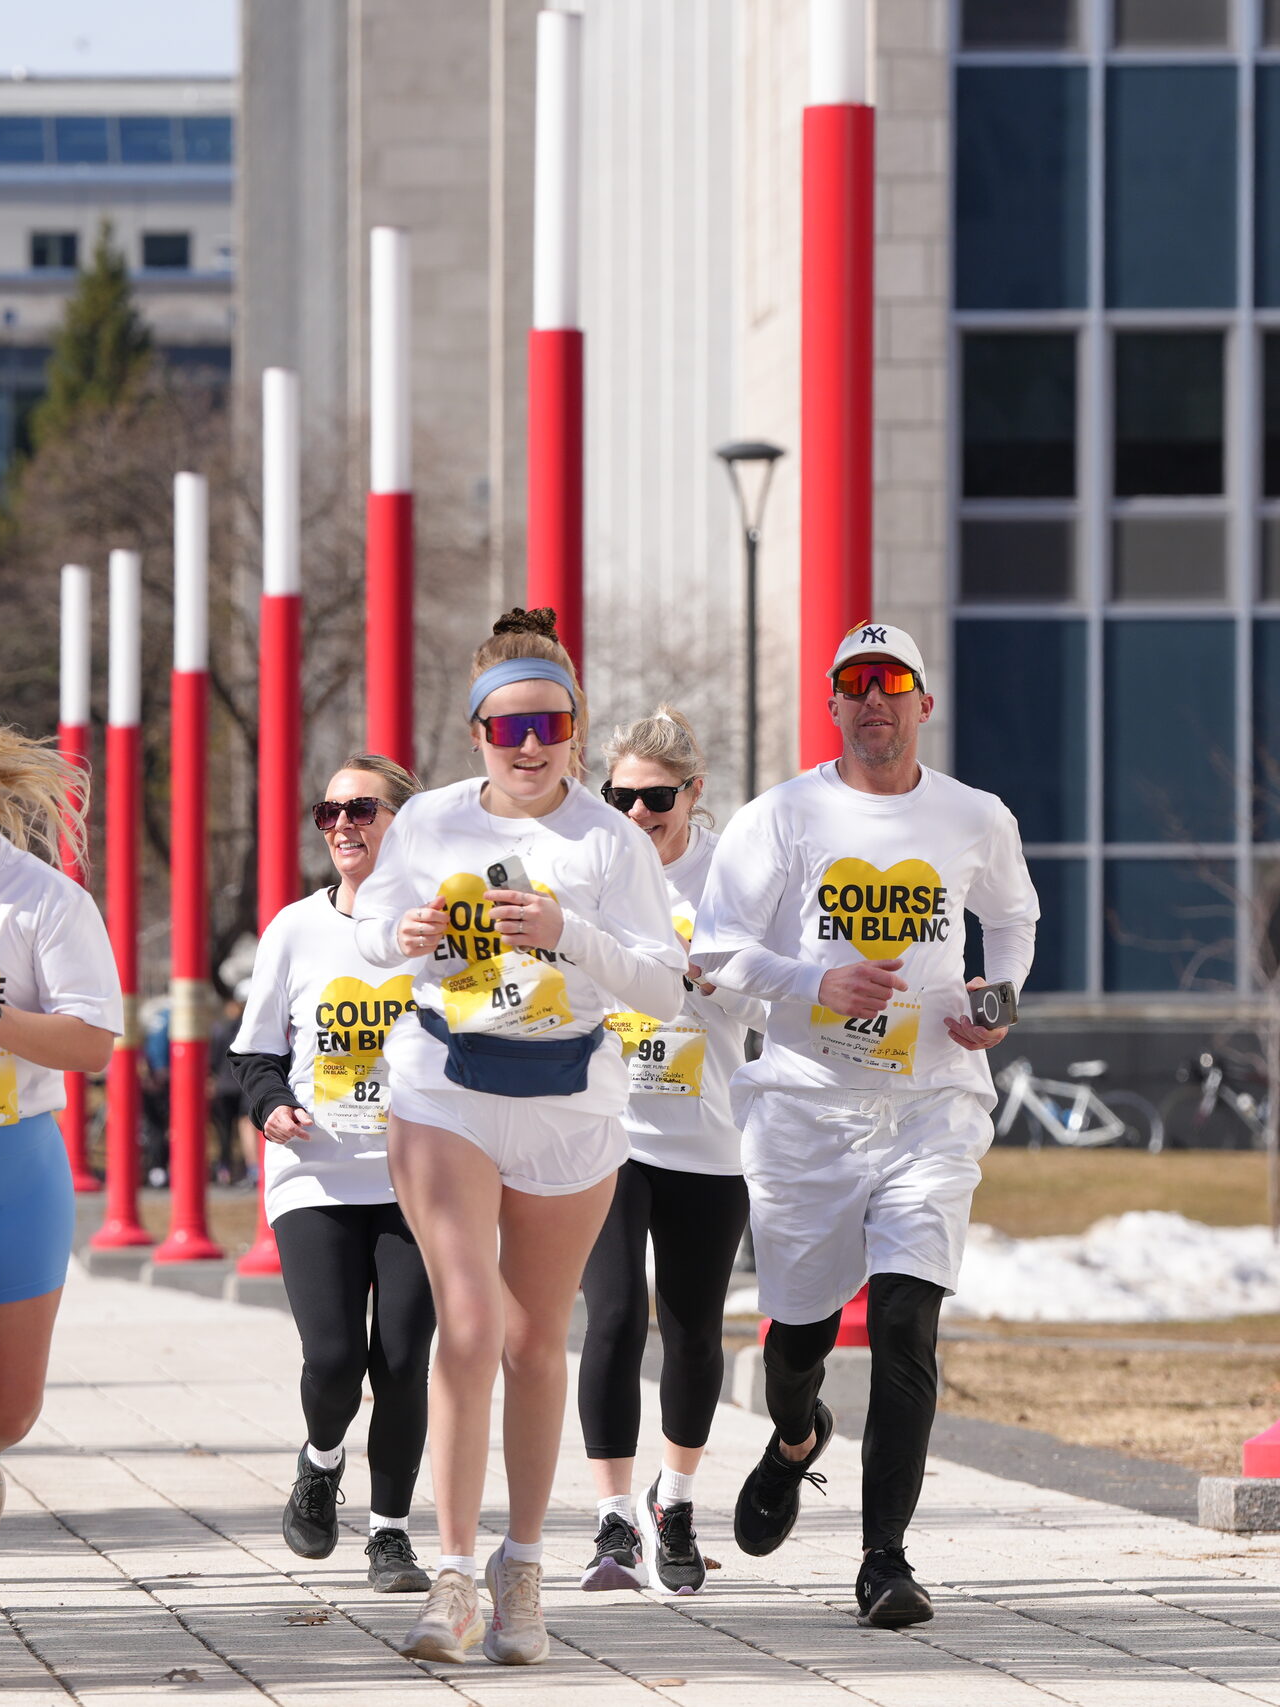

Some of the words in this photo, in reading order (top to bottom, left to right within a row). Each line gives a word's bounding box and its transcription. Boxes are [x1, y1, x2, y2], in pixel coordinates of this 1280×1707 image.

[817, 884, 947, 915] COURSE
[817, 915, 853, 940] EN
[861, 916, 950, 942] BLANC
[449, 976, 473, 987] COURSE
[492, 983, 522, 1010] 46
[317, 1031, 351, 1052] EN
[638, 1039, 666, 1062] 98
[354, 1081, 380, 1102] 82
